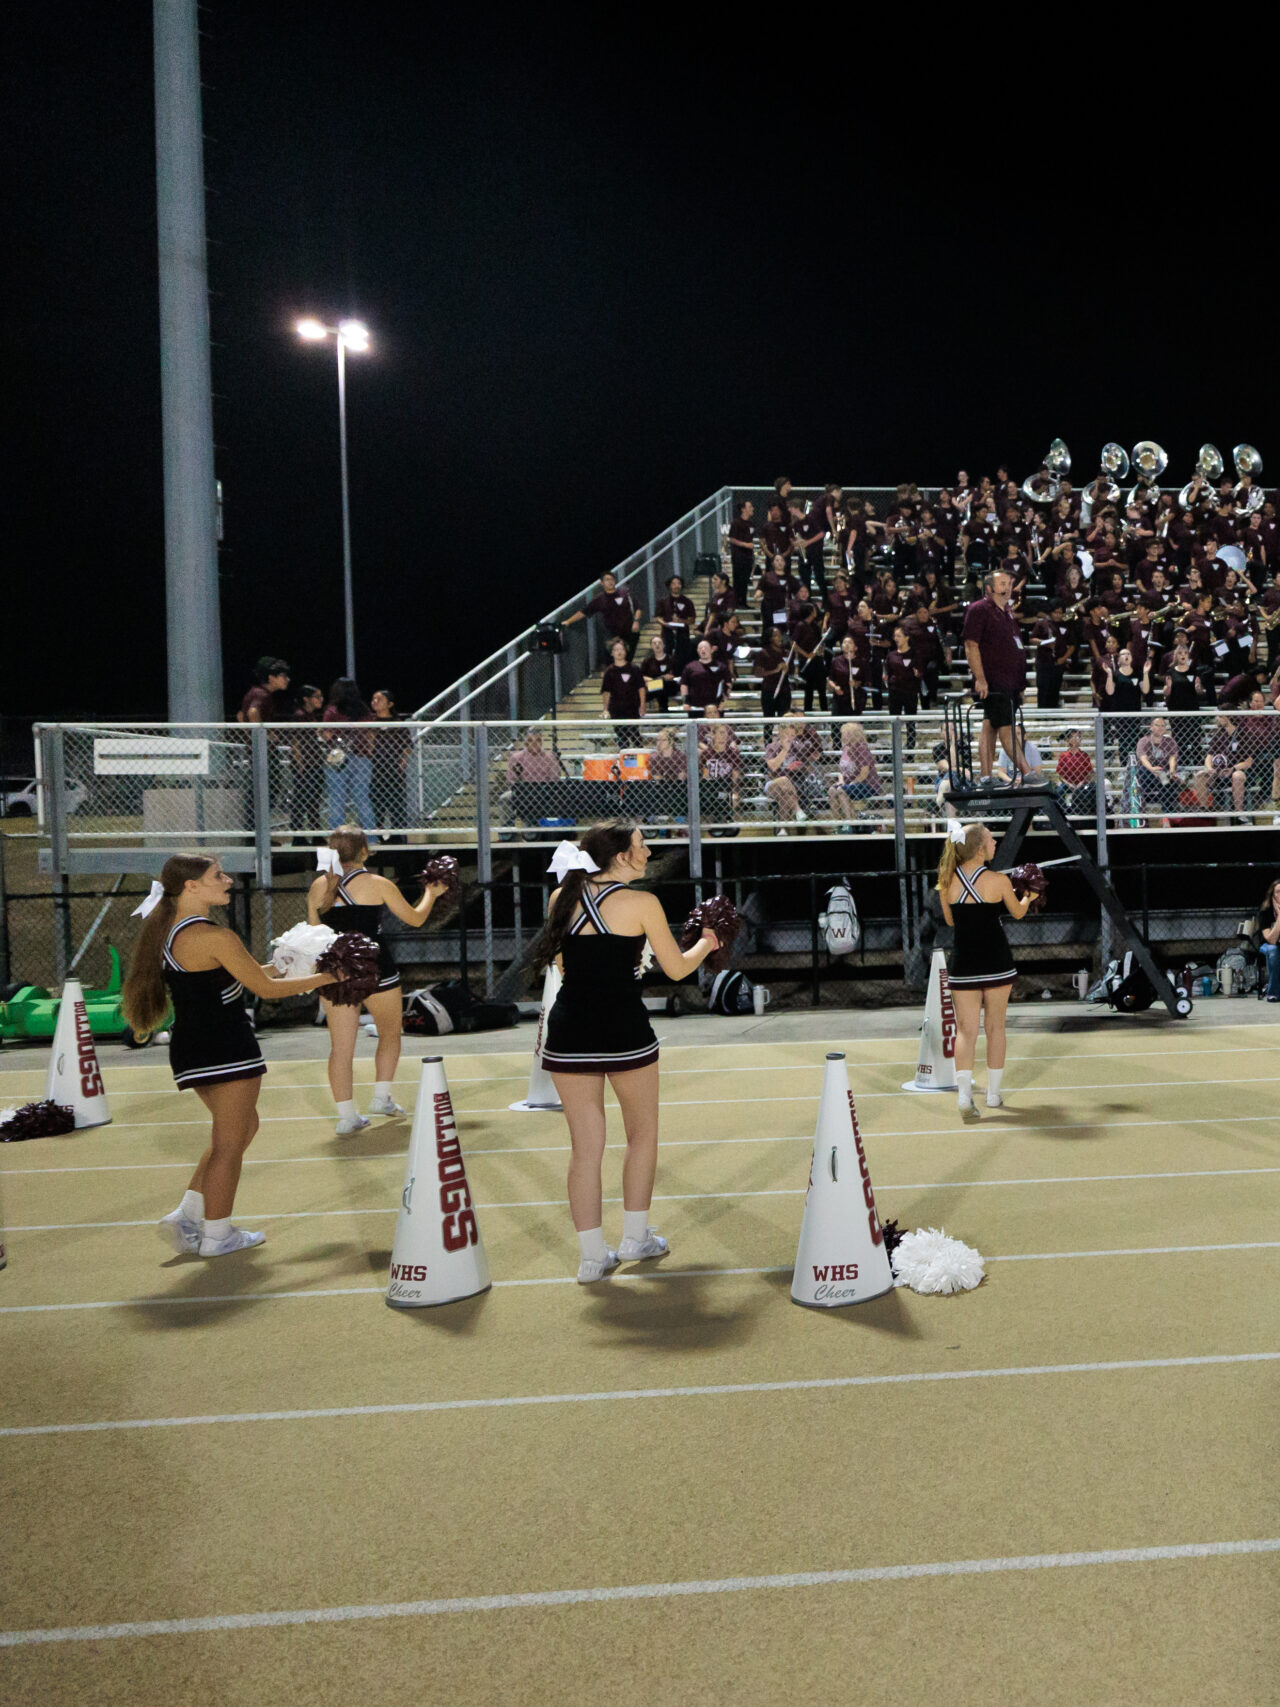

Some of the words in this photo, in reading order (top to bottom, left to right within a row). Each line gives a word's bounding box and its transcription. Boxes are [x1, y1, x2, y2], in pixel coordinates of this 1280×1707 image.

[831, 927, 847, 939] W
[939, 968, 958, 1059] BULLDOGS
[73, 1001, 105, 1099] BULLDOGS
[433, 1091, 478, 1254] BULLDOGS
[391, 1262, 428, 1281] WHS
[812, 1263, 859, 1282] WHS
[388, 1282, 422, 1298] Cheer
[813, 1284, 856, 1301] Cheer
